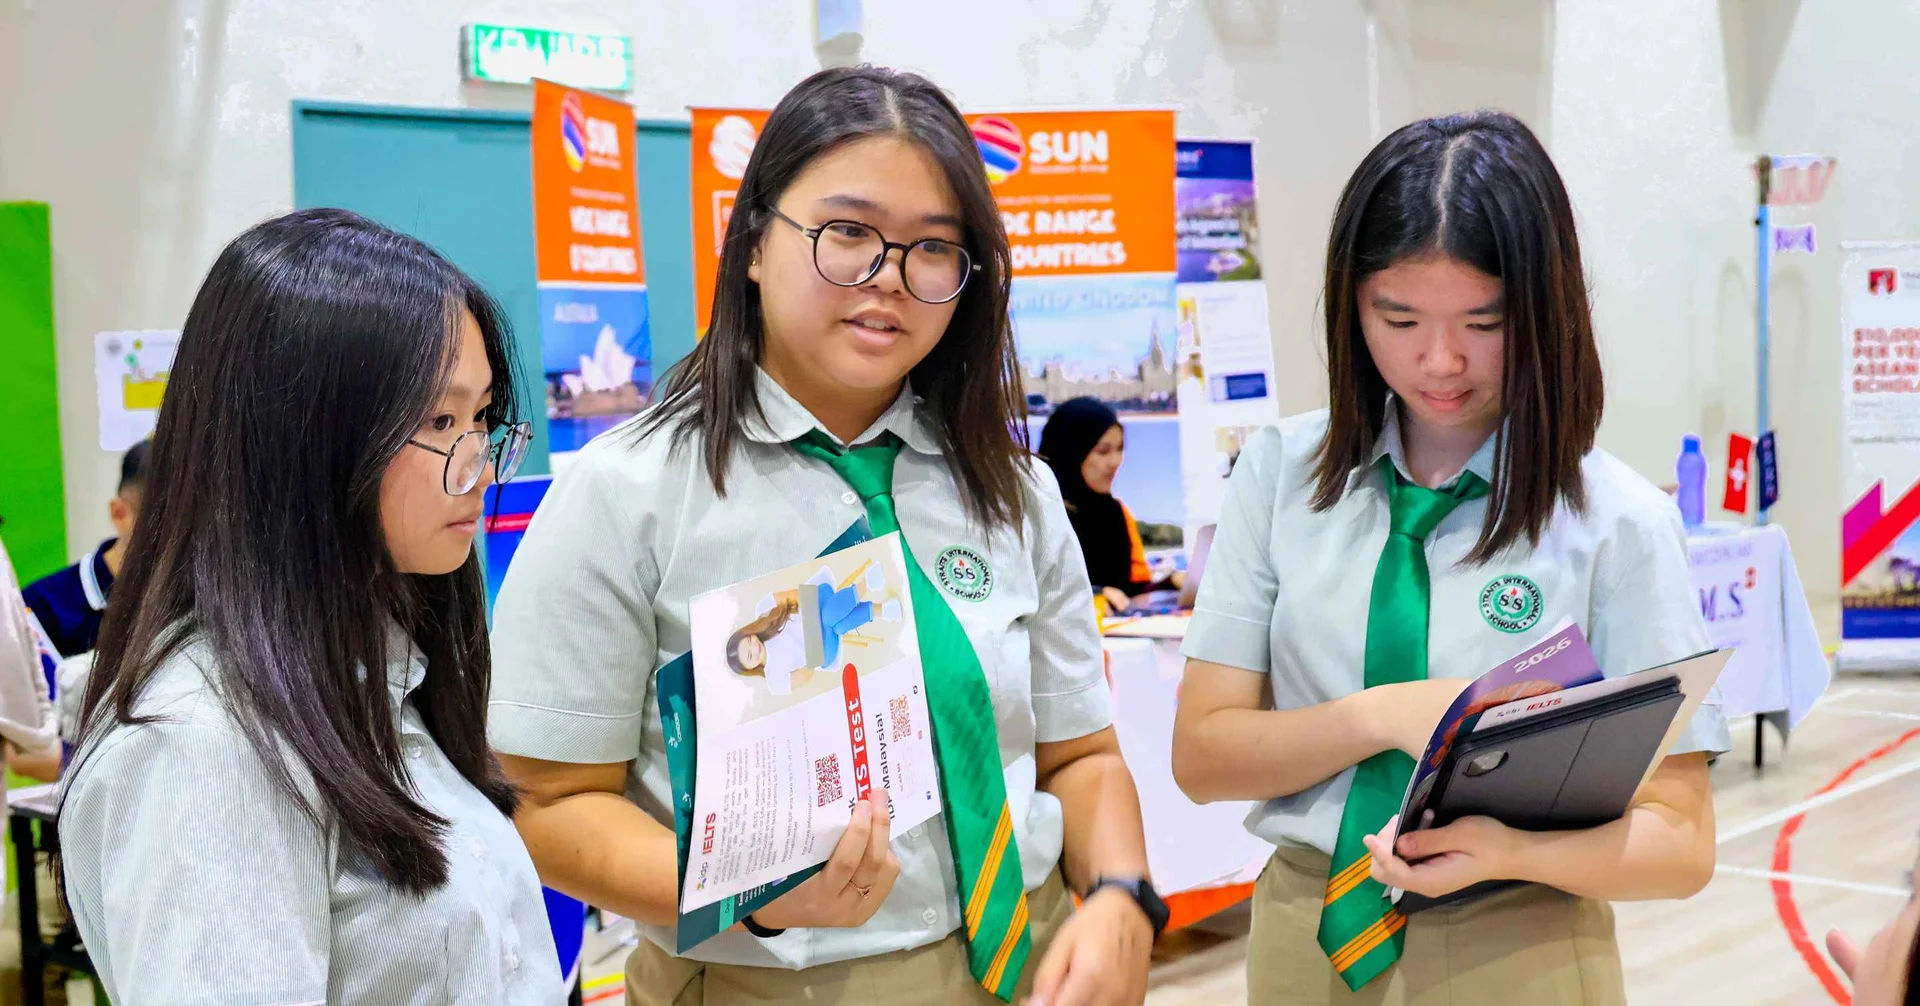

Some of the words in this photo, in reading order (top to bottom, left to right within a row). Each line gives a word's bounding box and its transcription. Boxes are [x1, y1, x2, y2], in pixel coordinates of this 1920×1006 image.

[1029, 130, 1109, 164] SUN
[1002, 211, 1031, 236] DE
[1034, 208, 1116, 235] RANGE
[1011, 241, 1127, 270] OUNTRIES
[1488, 613, 1523, 630] SCHOOL
[1513, 636, 1572, 674] 2026
[1525, 697, 1563, 712] IELTS
[848, 697, 865, 759] Test
[856, 763, 870, 799] TS
[702, 812, 717, 855] IELTS
[698, 861, 709, 880] idp
